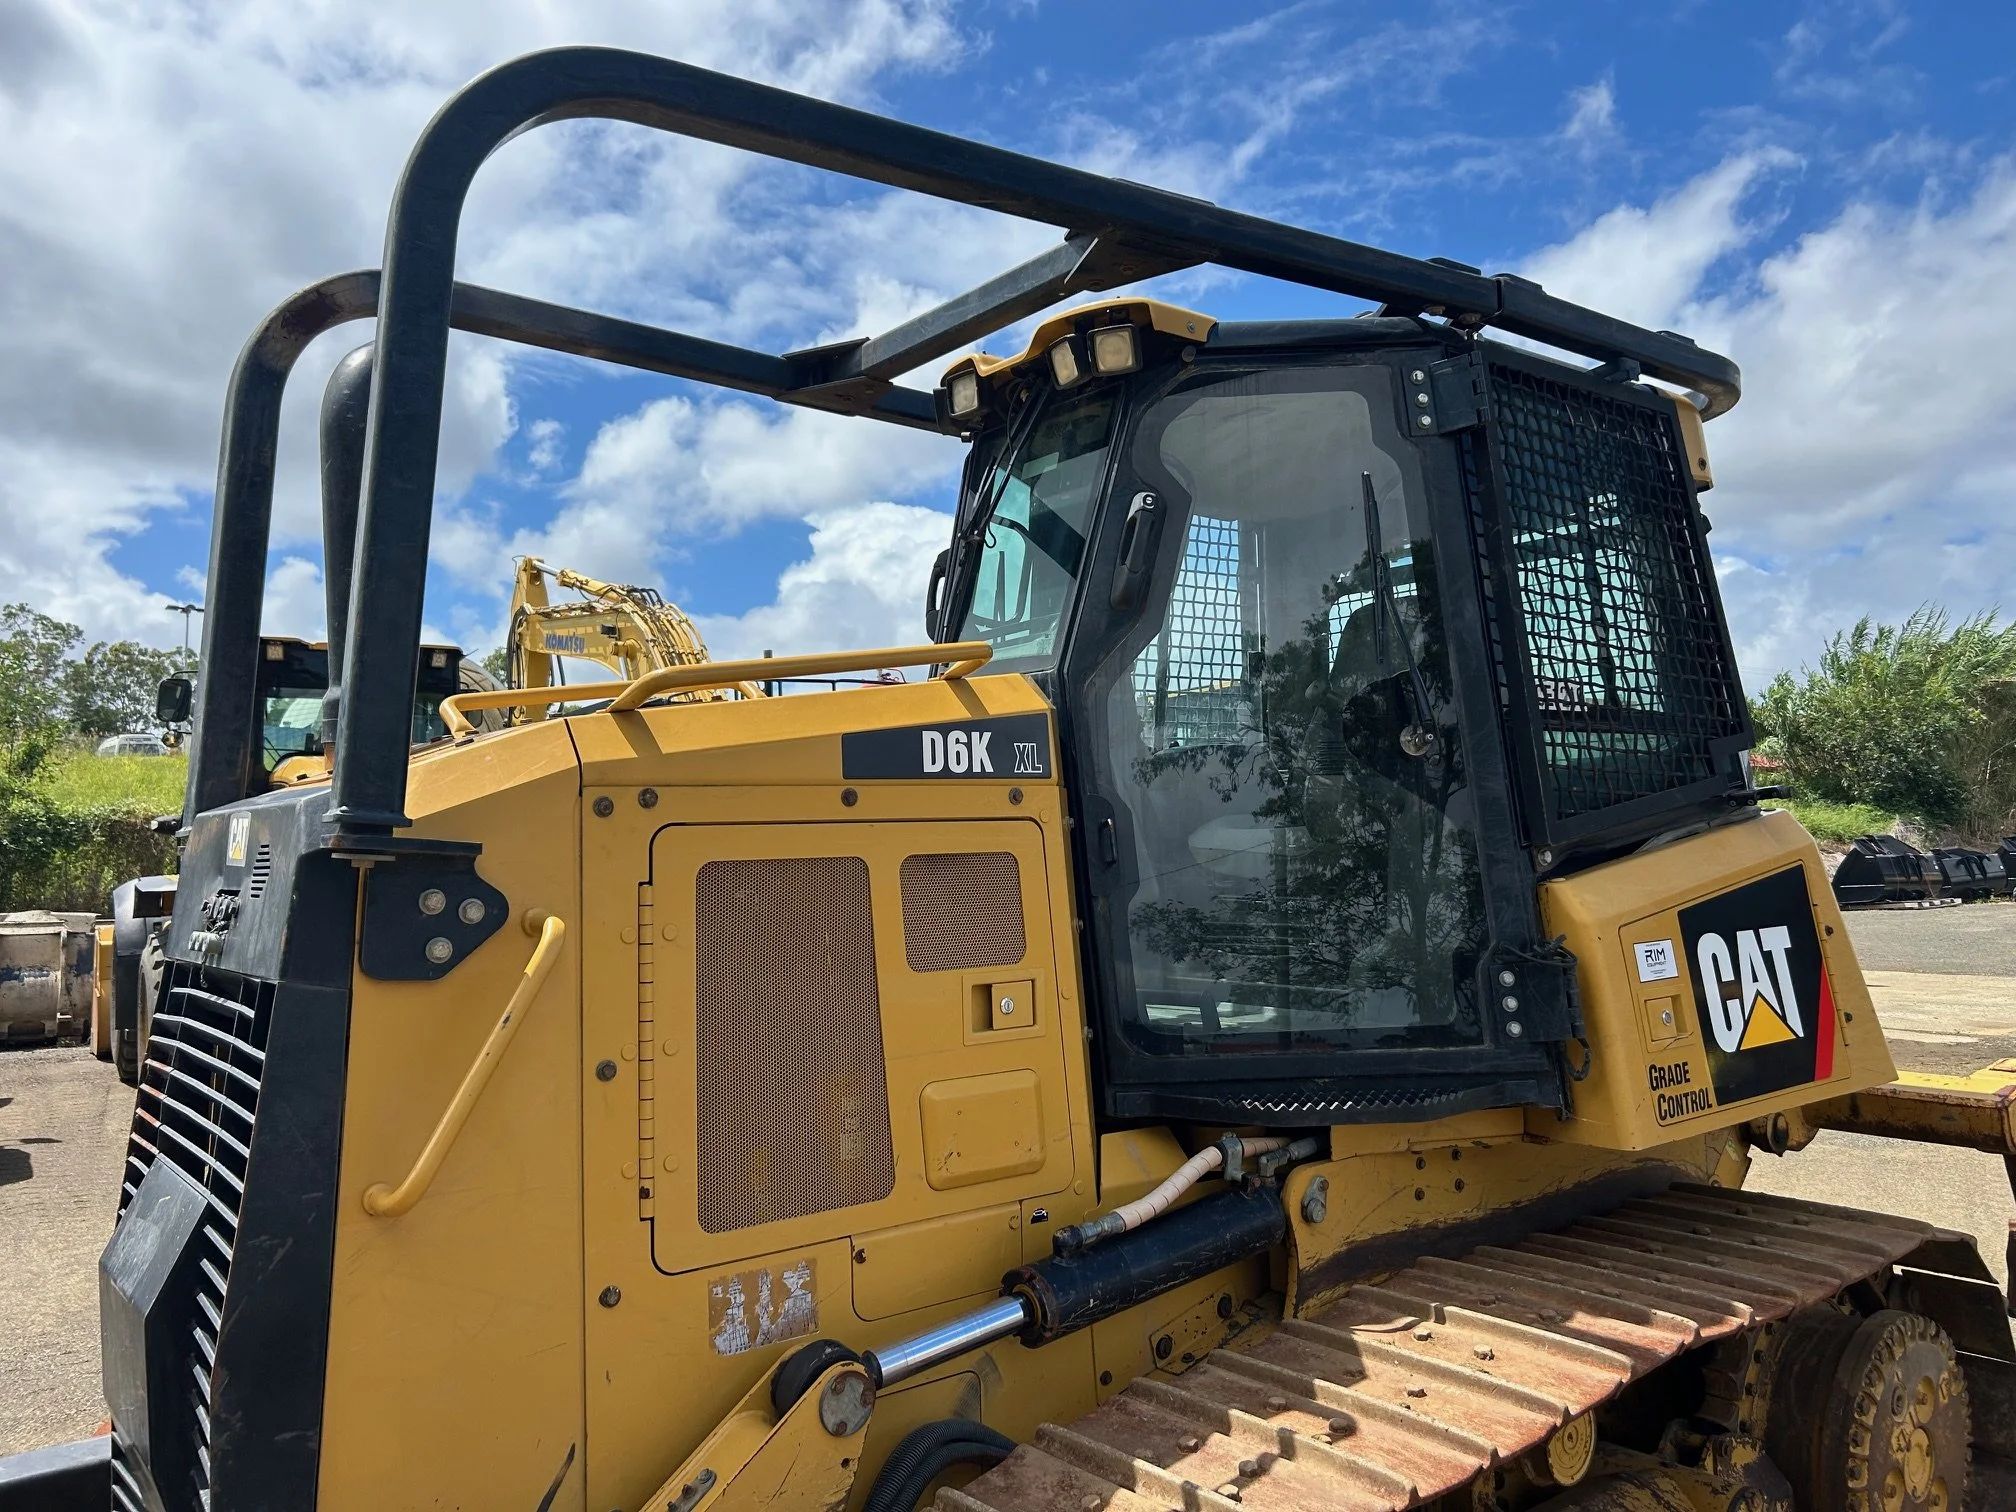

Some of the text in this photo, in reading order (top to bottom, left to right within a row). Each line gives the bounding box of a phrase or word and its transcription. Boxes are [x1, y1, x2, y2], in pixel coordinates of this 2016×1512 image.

[545, 632, 585, 654] KOMATSU
[922, 730, 1043, 774] D6K XL
[229, 816, 250, 860] CAT
[1645, 948, 1666, 962] RIM
[1697, 926, 1804, 1053] CAT
[1648, 1061, 1691, 1092] GRADE
[1657, 1087, 1713, 1121] CONTROL
